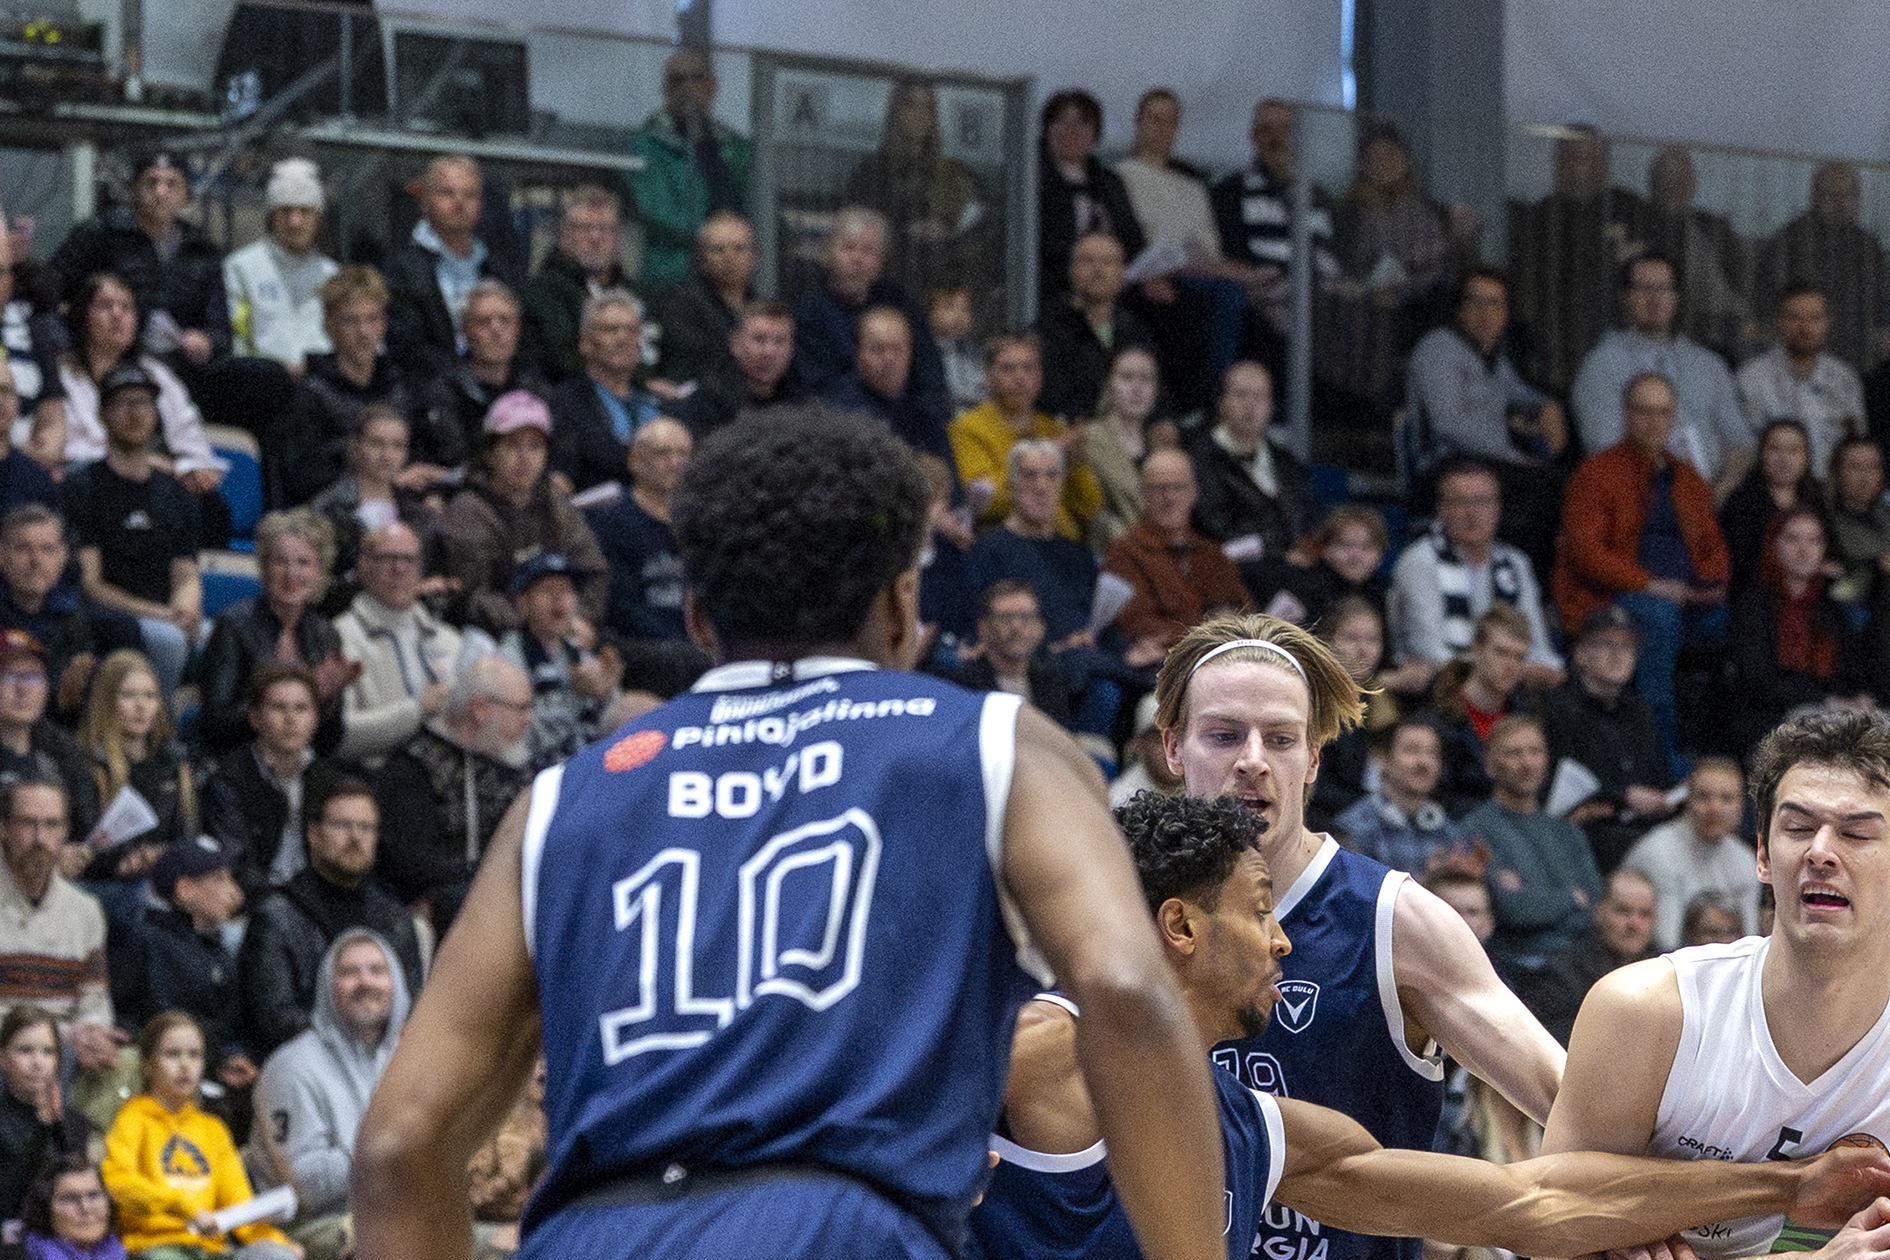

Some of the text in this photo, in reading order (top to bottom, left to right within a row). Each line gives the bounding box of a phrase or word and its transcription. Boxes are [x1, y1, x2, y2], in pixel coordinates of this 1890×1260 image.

[667, 739, 845, 820] BOYD
[599, 806, 883, 1067] 10
[1291, 985, 1315, 995] OULU
[1677, 1135, 1722, 1160] CRAFT
